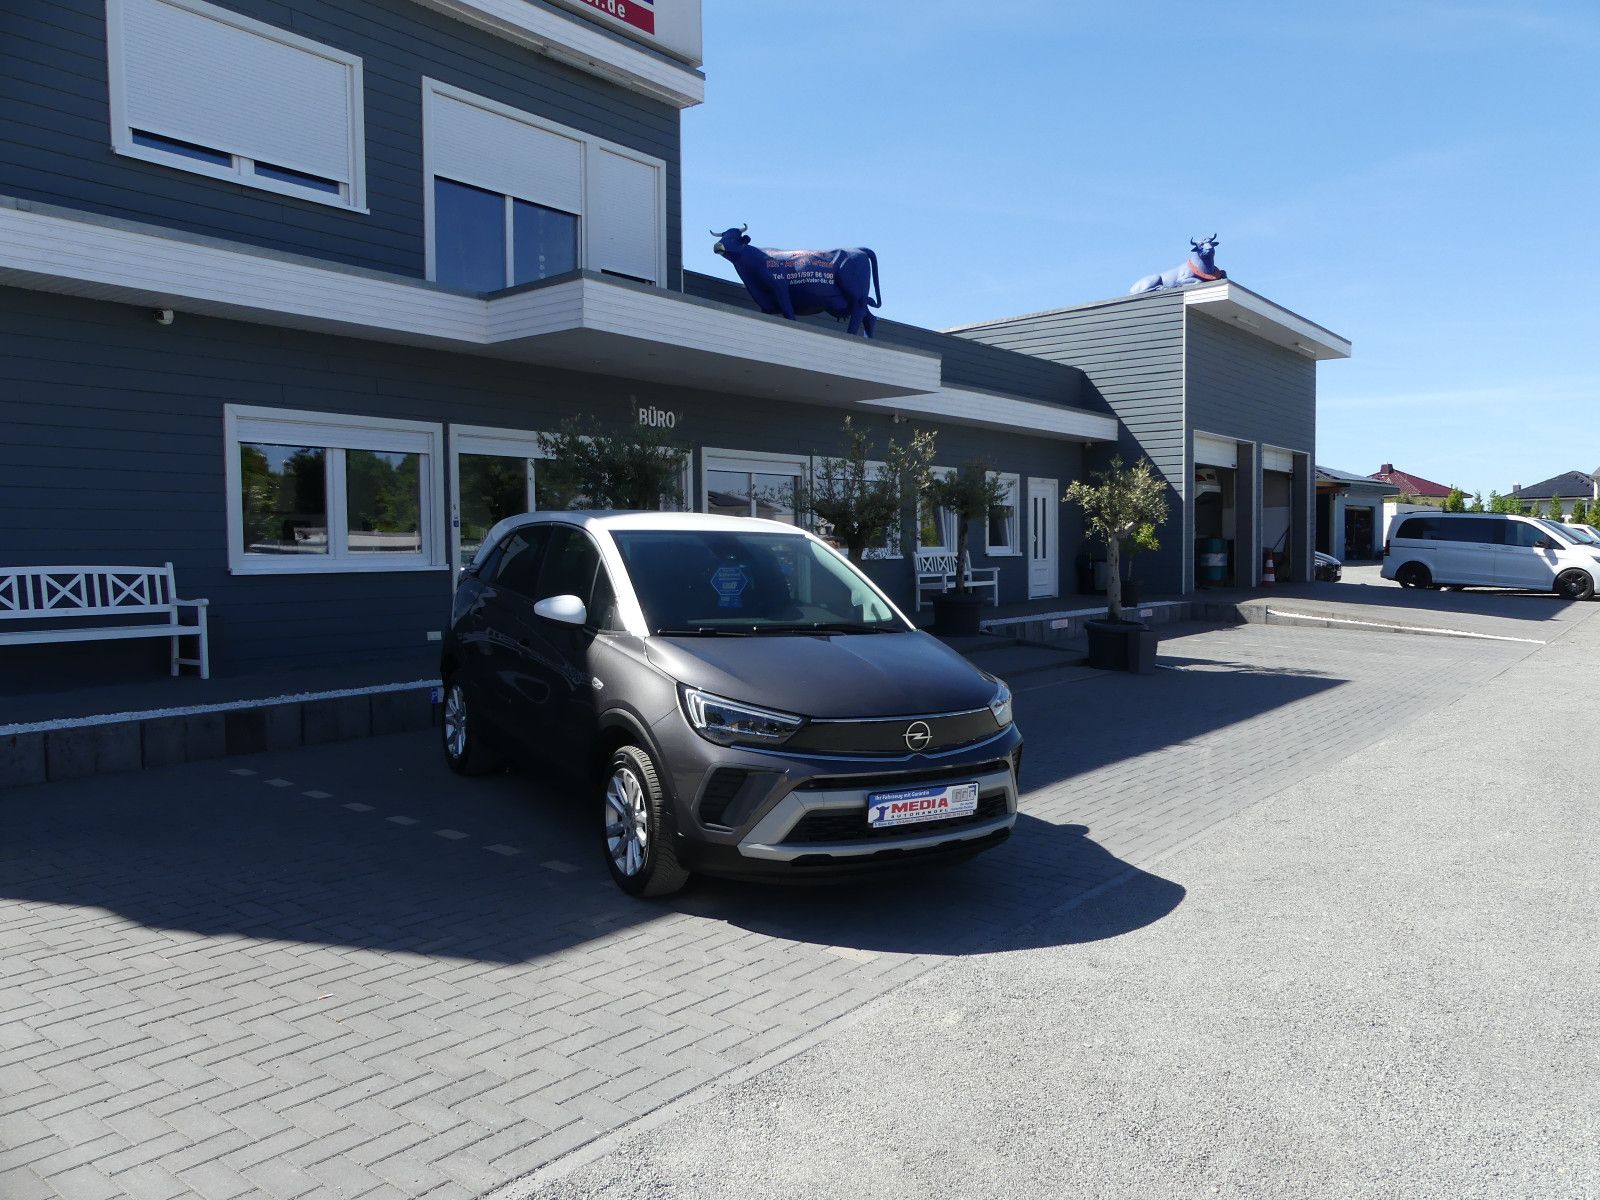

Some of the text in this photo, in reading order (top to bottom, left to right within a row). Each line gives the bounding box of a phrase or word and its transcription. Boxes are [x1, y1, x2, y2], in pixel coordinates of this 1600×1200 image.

[587, 0, 626, 18] .de
[639, 405, 675, 428] BÜRO
[891, 797, 948, 813] MEDIA
[891, 808, 948, 819] AUTOHANDEL
